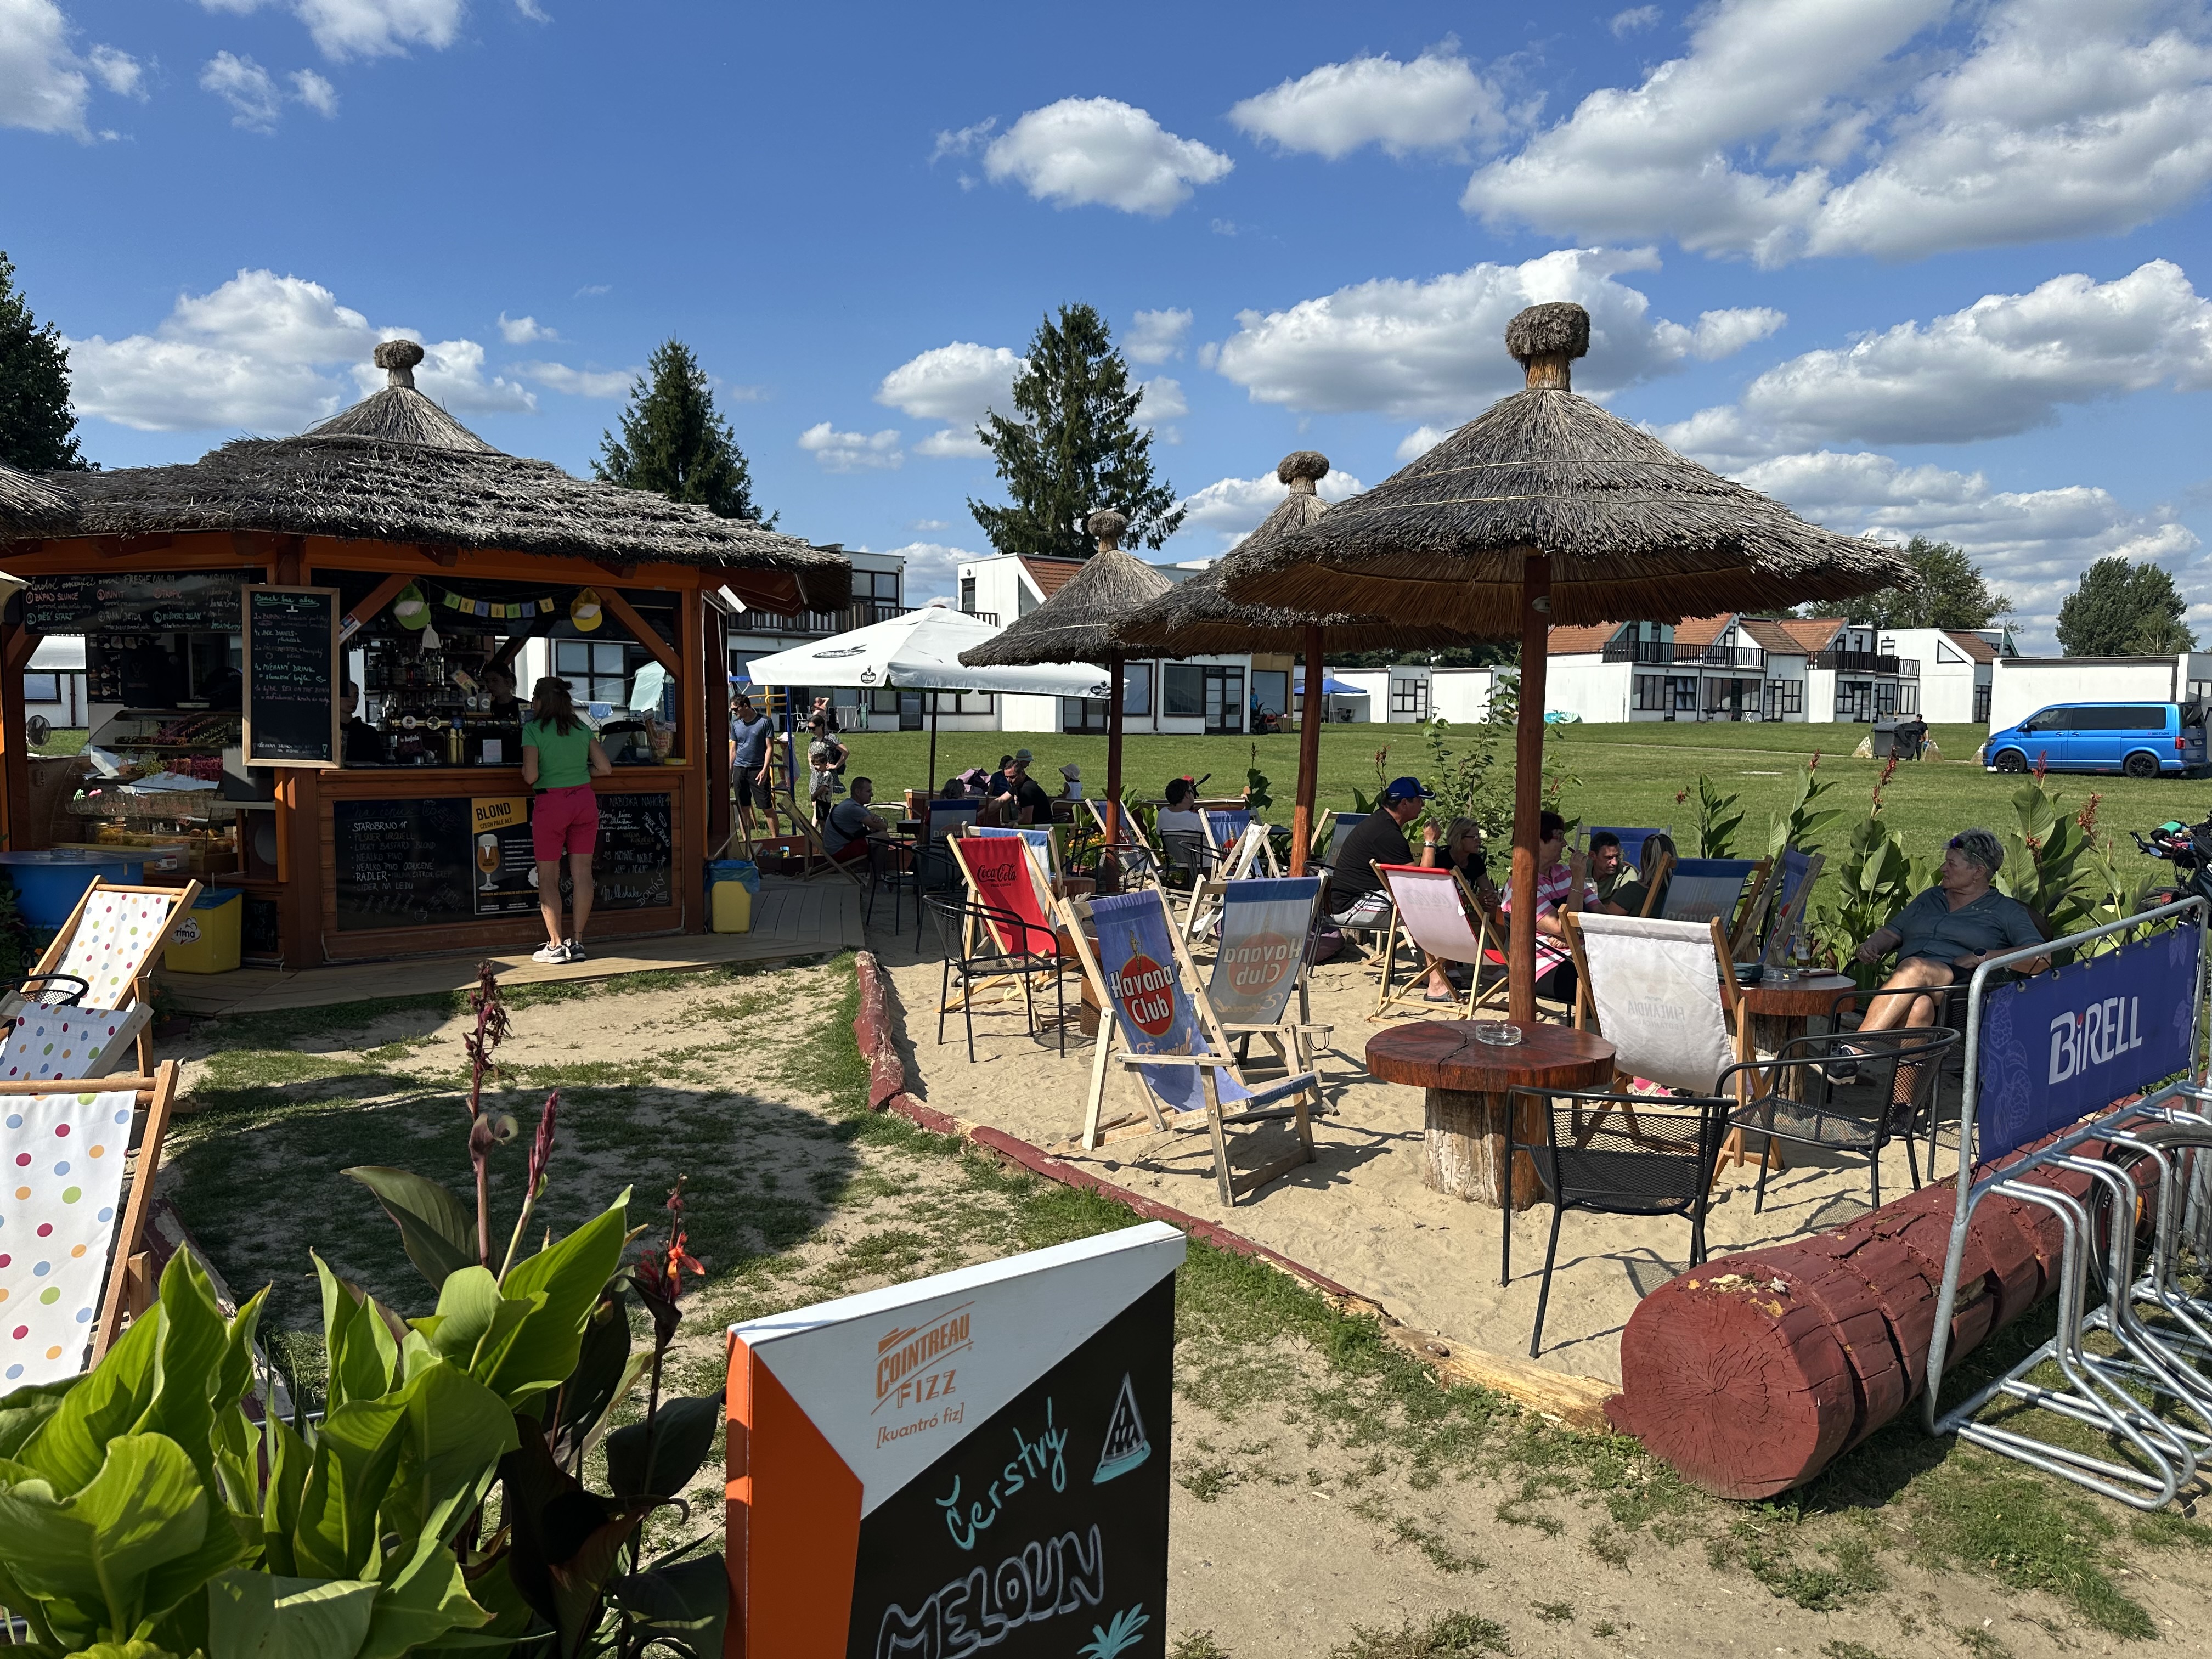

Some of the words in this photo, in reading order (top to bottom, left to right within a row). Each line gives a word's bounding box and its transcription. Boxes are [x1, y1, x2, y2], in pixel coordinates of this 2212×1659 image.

[476, 803, 511, 821] BLOND
[352, 821, 397, 832] STAROBRNO
[479, 821, 493, 829] CZECH
[379, 842, 410, 851] BASTARD
[356, 853, 384, 862] NEALKO
[387, 852, 403, 861] PIVO
[356, 864, 382, 872] NEALKO
[385, 862, 398, 871] PIVO
[356, 883, 379, 891] CIDER
[395, 881, 413, 889] LEDU
[176, 928, 195, 938] rima
[1109, 964, 1176, 999] Havana
[1131, 993, 1171, 1024] Club
[876, 1313, 970, 1400] COINTREAU
[897, 1369, 956, 1409] FIZZ
[876, 1414, 939, 1450] [kuantró
[943, 1402, 965, 1425] fiz]
[936, 1396, 1068, 1551] Čerstvý
[876, 1523, 1104, 1659] MELOUN
